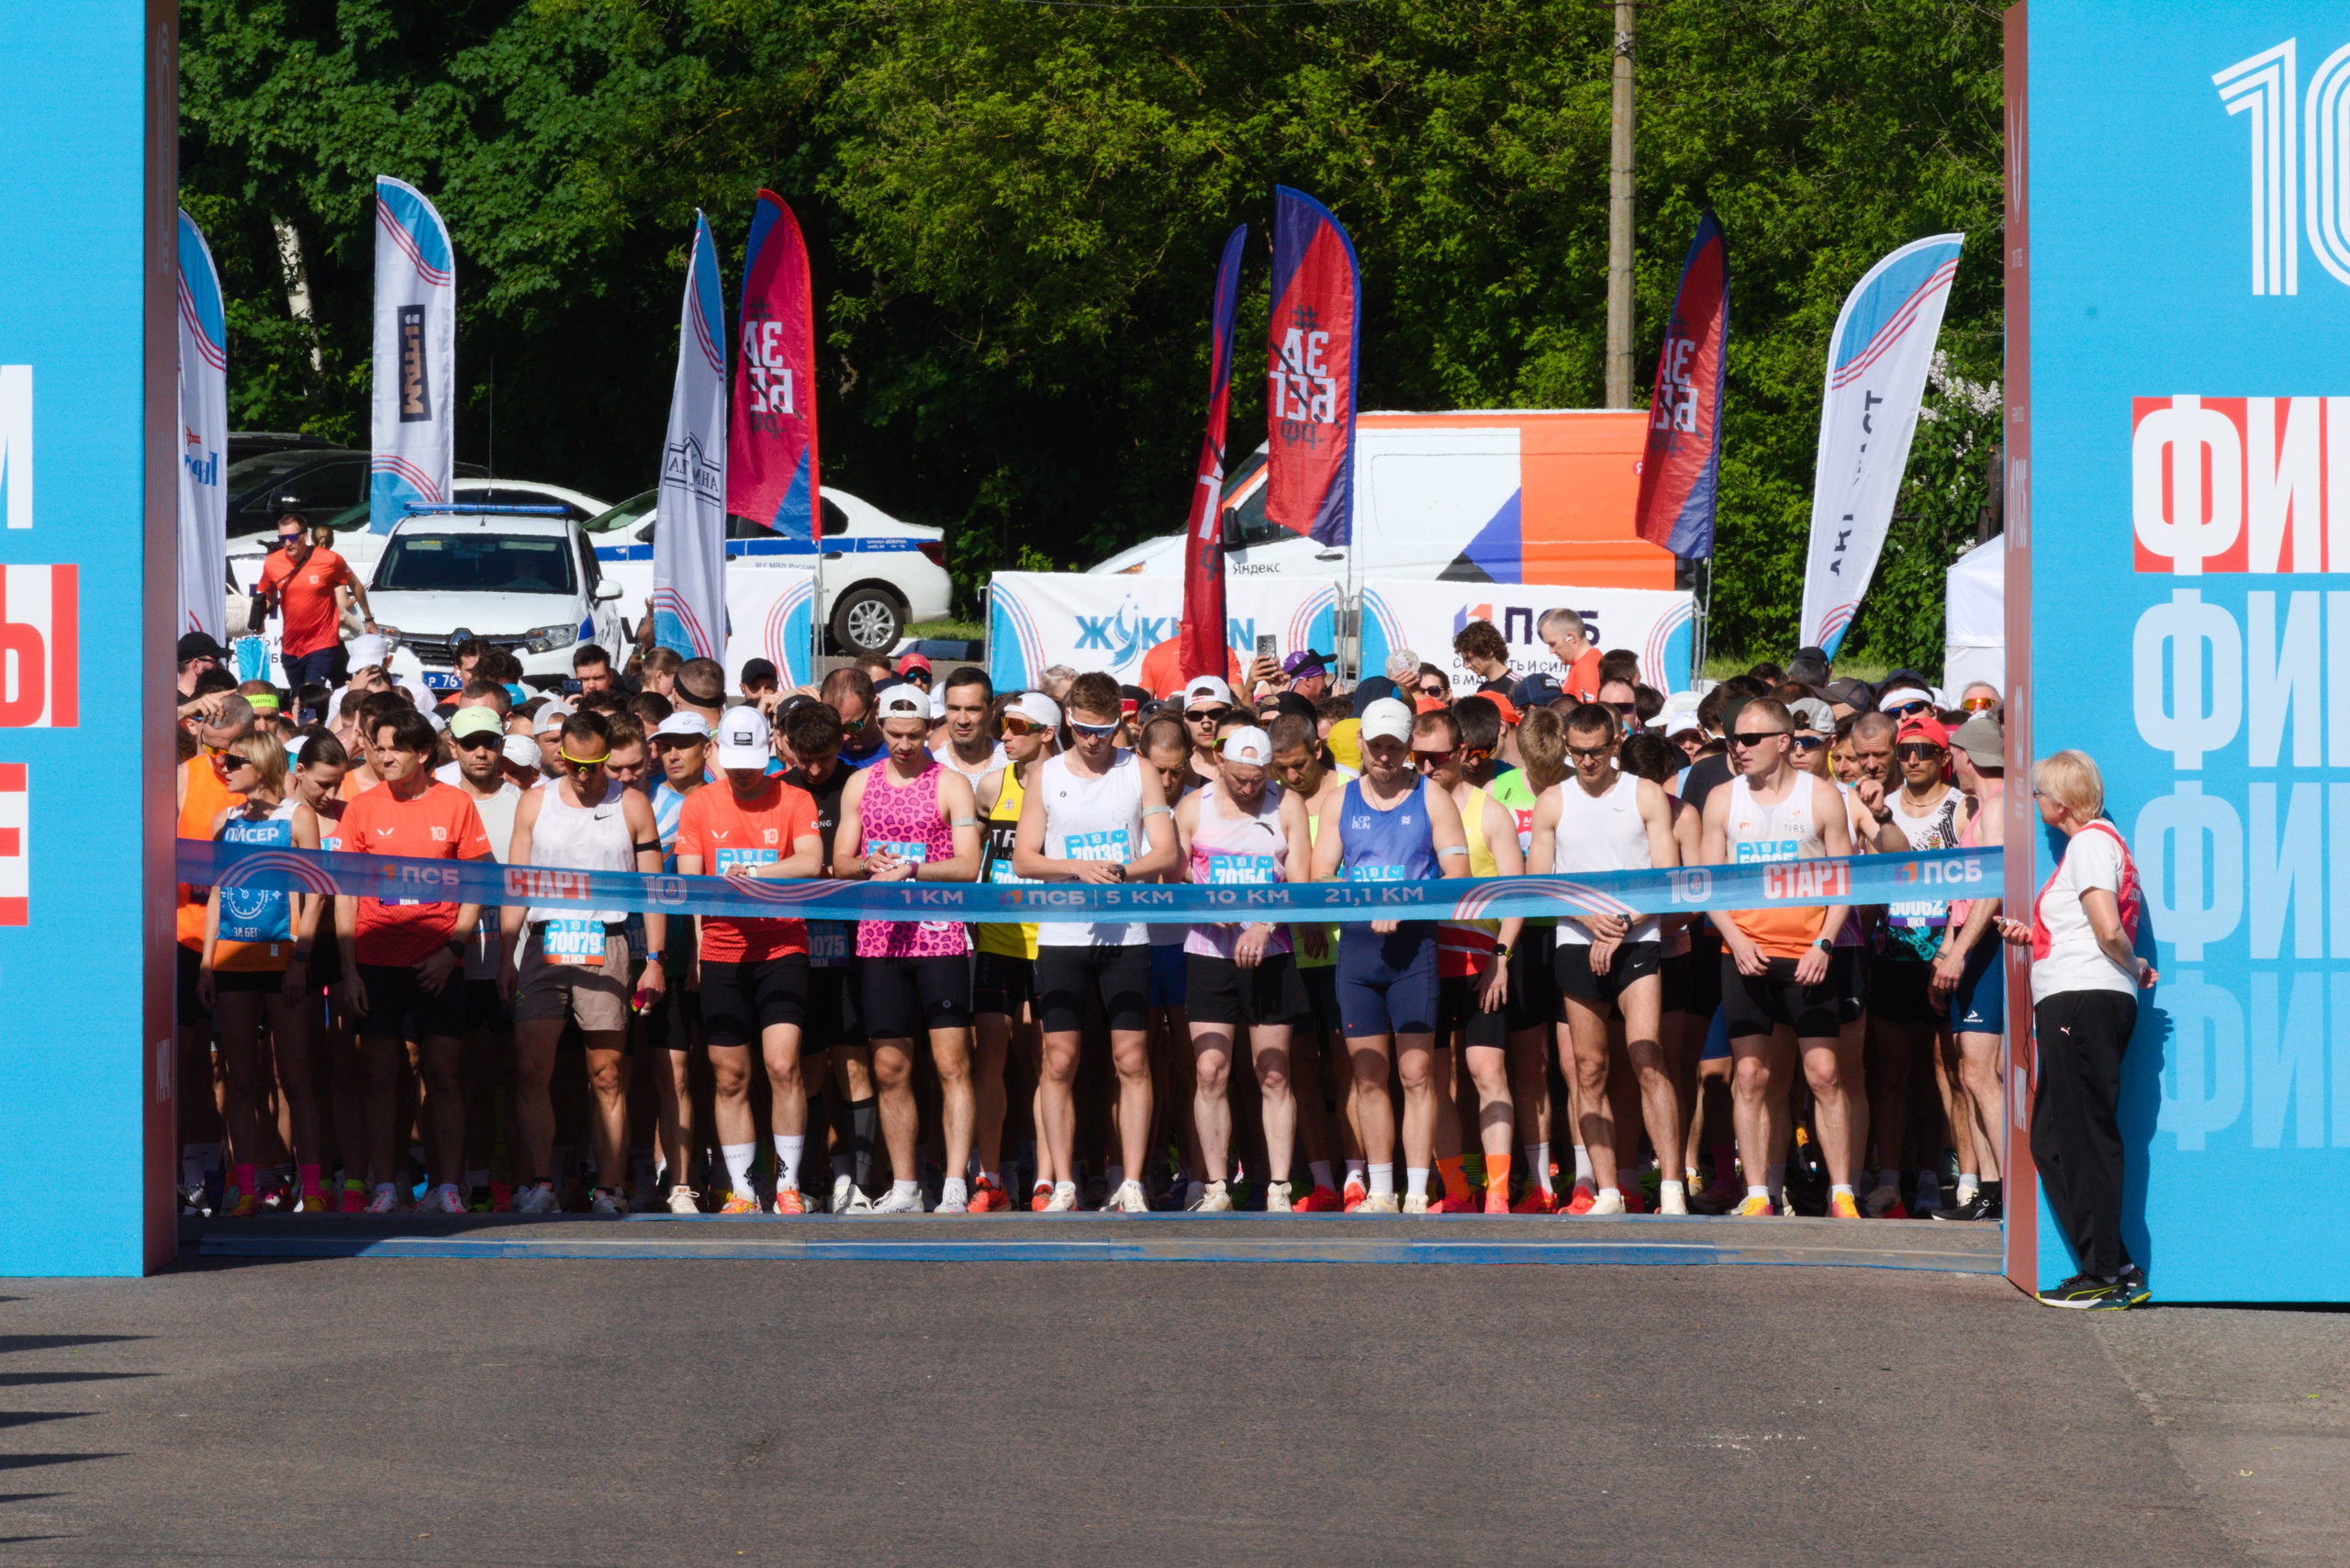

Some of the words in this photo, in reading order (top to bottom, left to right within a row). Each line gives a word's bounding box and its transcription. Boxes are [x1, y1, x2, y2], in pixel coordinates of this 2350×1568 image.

[1233, 563, 1281, 575] Яндекс
[401, 866, 459, 886] ПСБ
[505, 868, 590, 900] СТАРТ
[1028, 890, 1087, 905] ПСБ
[1106, 890, 1121, 904] 5
[1205, 890, 1237, 904] 10
[1325, 887, 1371, 906] 21,1
[1763, 860, 1850, 900] СТАРТ
[1924, 859, 1983, 884] ПСБ
[548, 931, 600, 954] 70079
